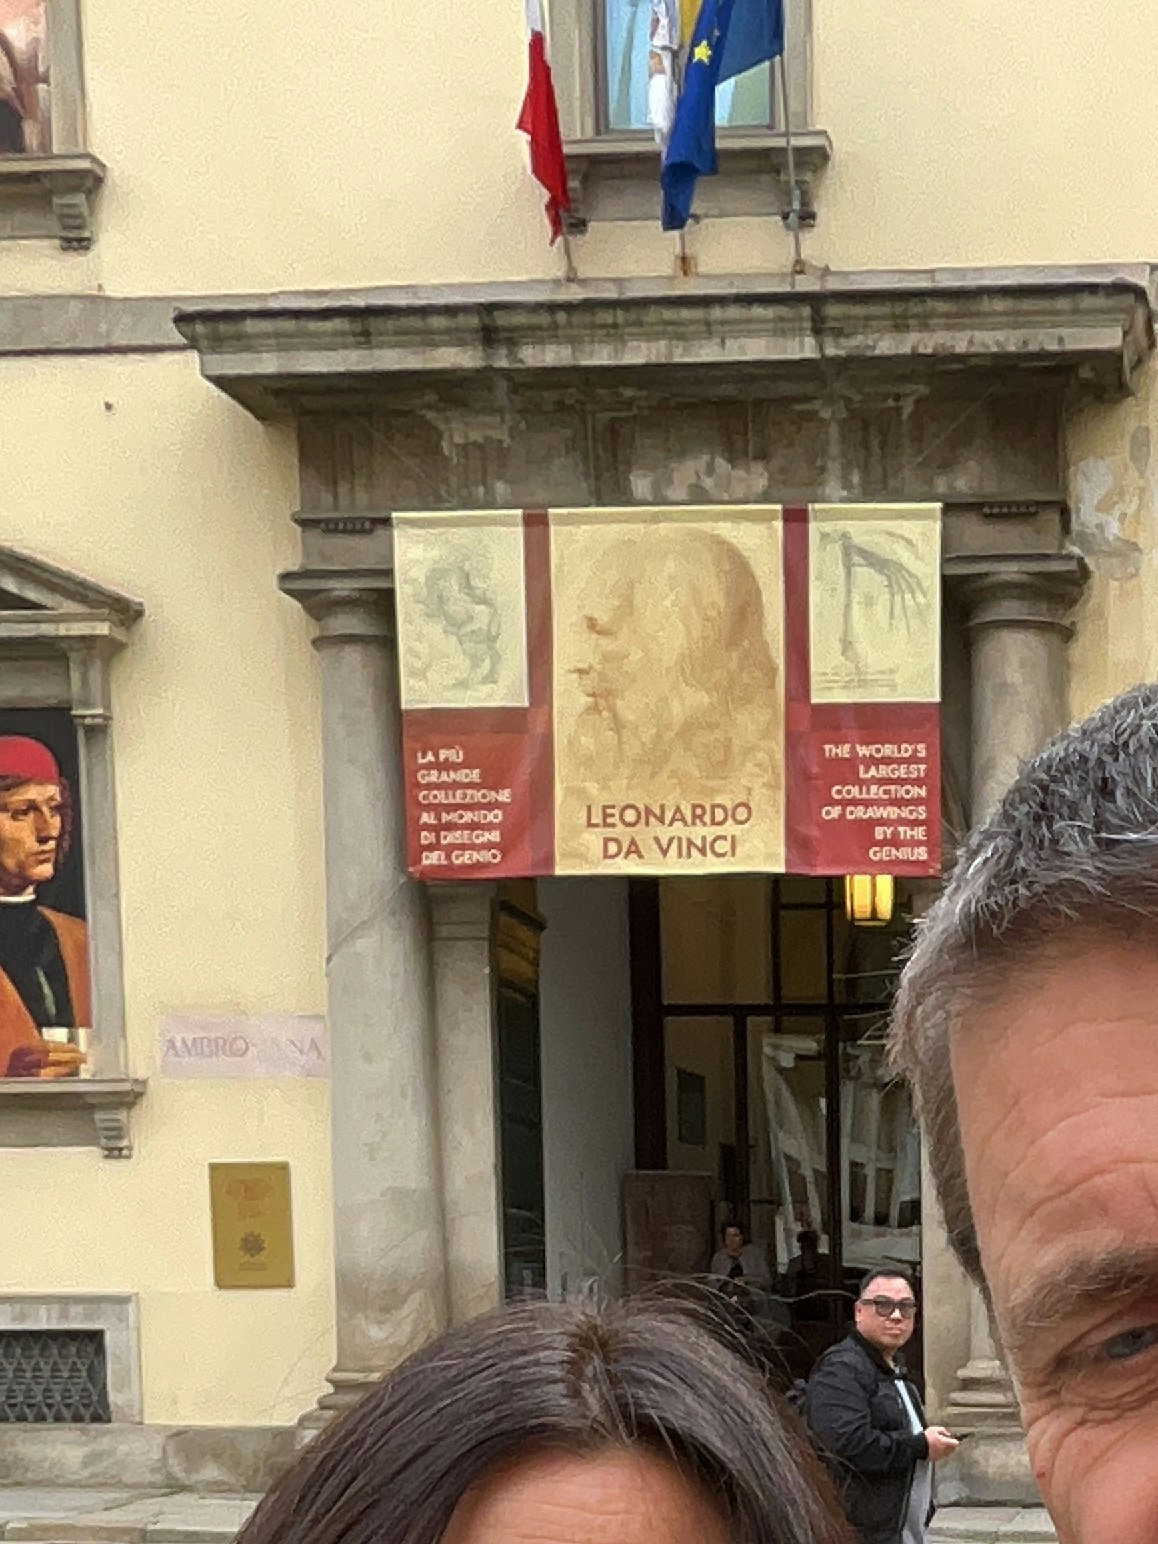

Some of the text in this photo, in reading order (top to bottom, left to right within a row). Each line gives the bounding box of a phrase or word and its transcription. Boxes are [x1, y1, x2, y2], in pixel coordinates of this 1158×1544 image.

[417, 750, 436, 763] LA
[823, 743, 926, 758] THE WORLD'S
[417, 768, 482, 783] GRANDE
[859, 764, 928, 779] LARGEST
[419, 788, 512, 803] COLLEZIONE
[831, 784, 927, 800] COLLECTION
[419, 808, 503, 825] AL MONDO
[584, 801, 752, 828] LEONARDO
[821, 804, 927, 820] OF DRAWINGS
[420, 830, 501, 845] DI DISEGNI
[875, 826, 928, 840] BY THE
[602, 834, 736, 860] DA VINCI
[868, 846, 929, 861] GENIUS
[421, 849, 503, 865] DEL GENIO
